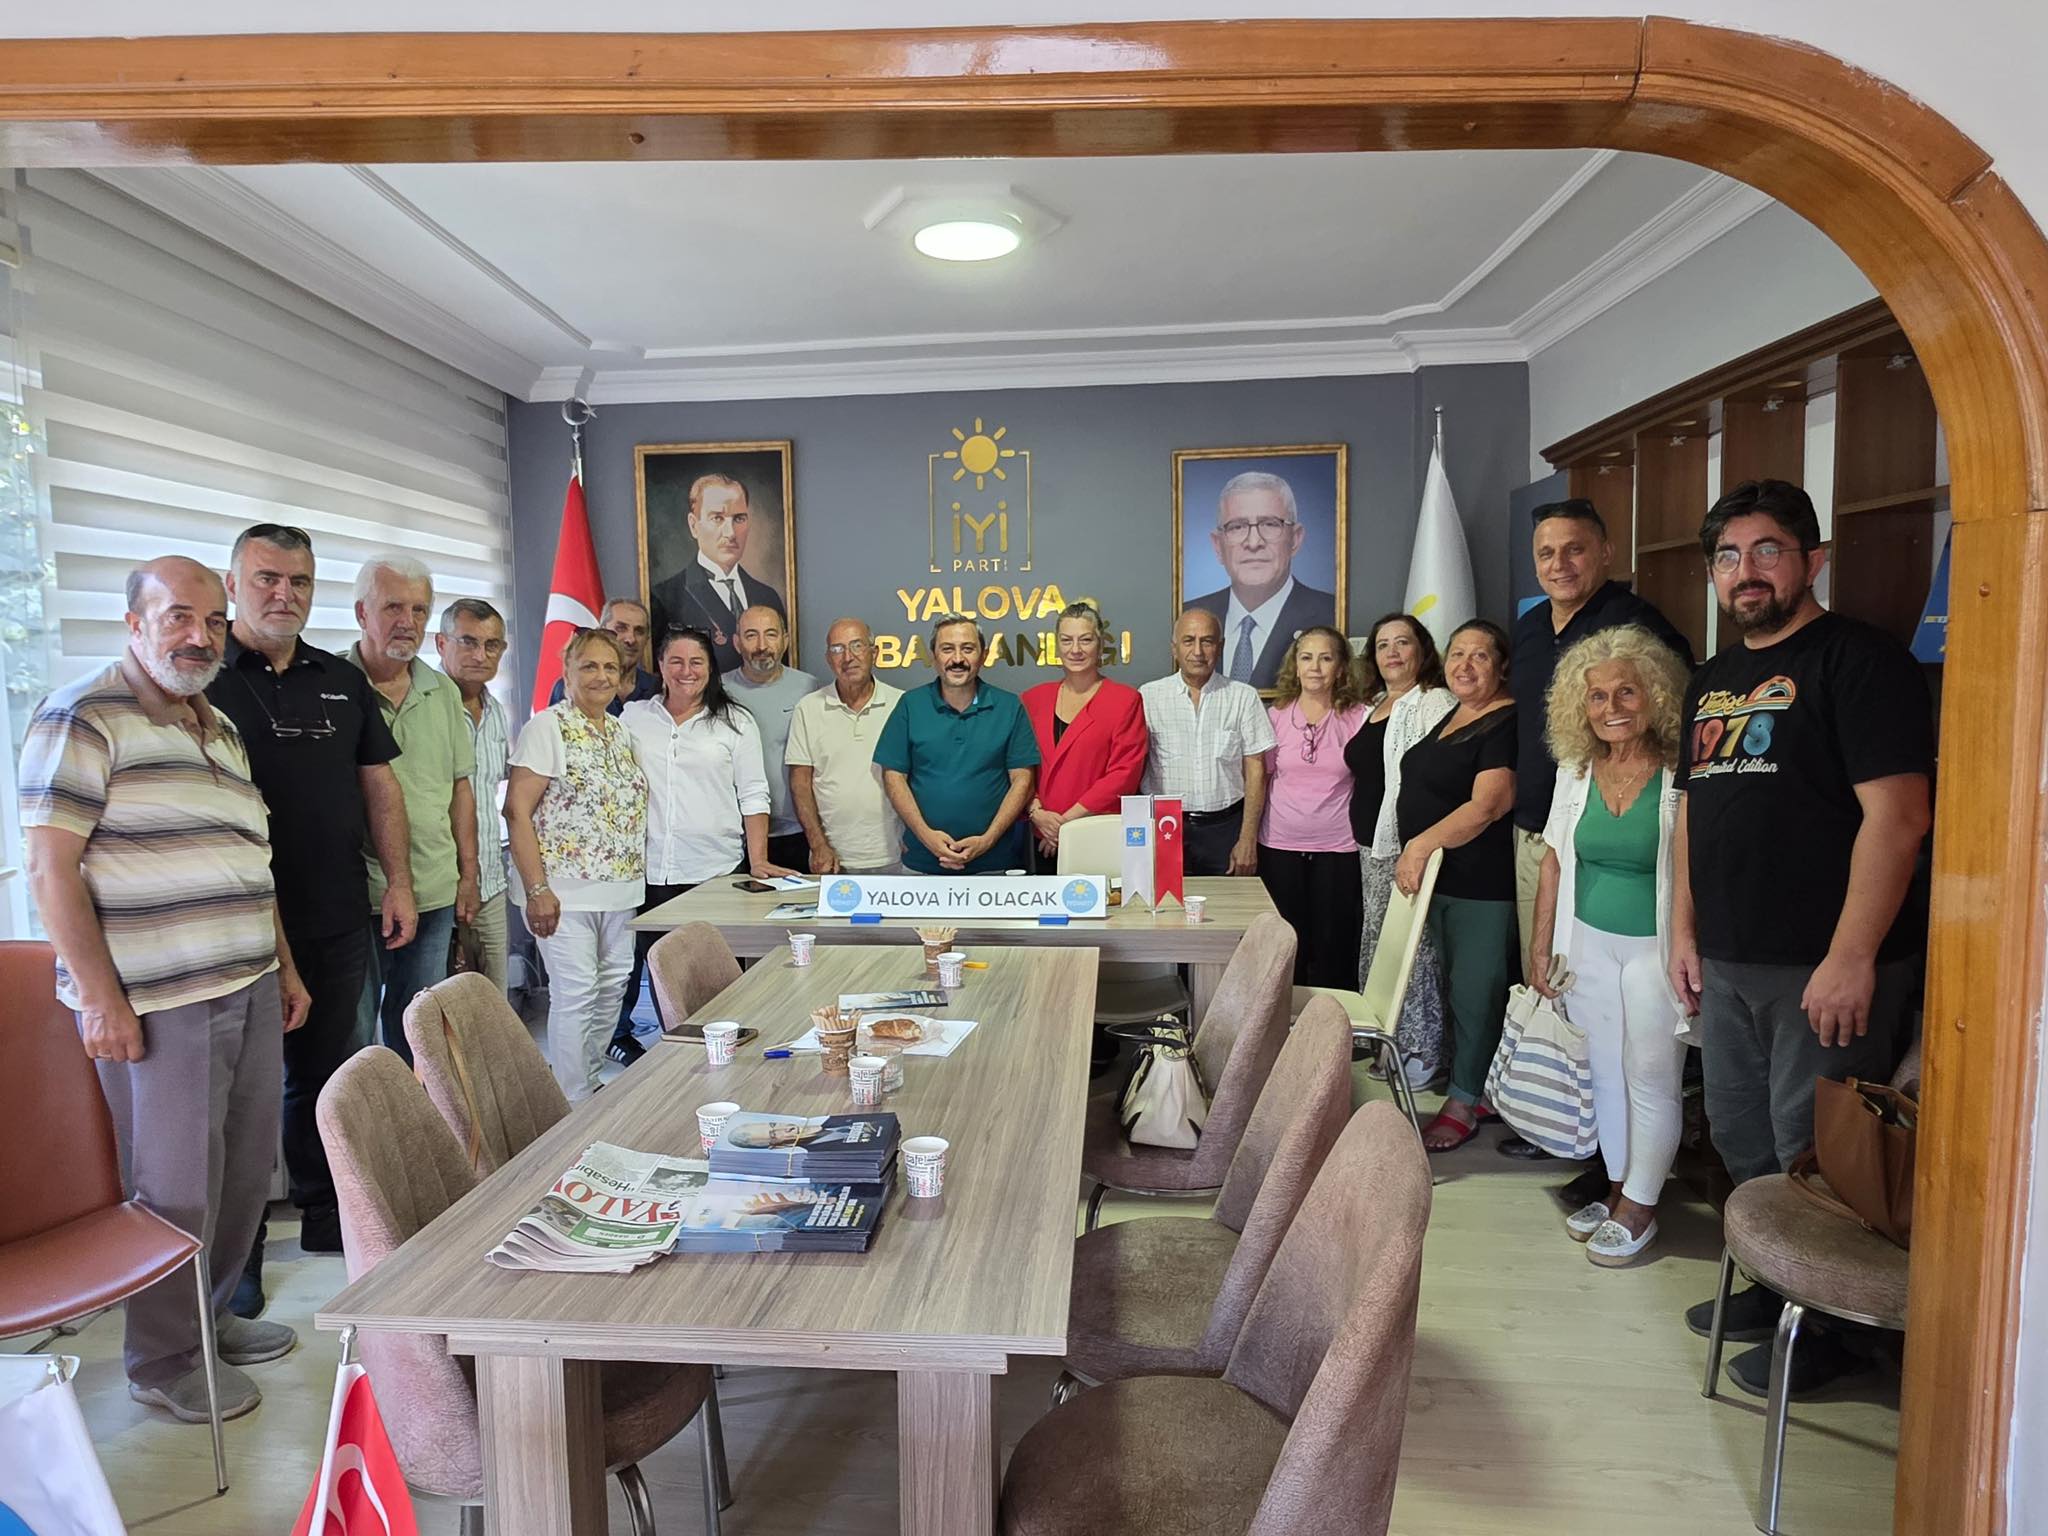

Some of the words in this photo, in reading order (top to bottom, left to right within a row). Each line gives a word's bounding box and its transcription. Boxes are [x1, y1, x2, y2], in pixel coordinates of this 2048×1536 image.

[951, 500, 1009, 554] İYİ
[896, 584, 1067, 622] YALOVA
[1737, 757, 1779, 774] Edition
[867, 891, 940, 906] YALOVA
[948, 887, 970, 906] İYİ
[978, 891, 1057, 907] OLACAK
